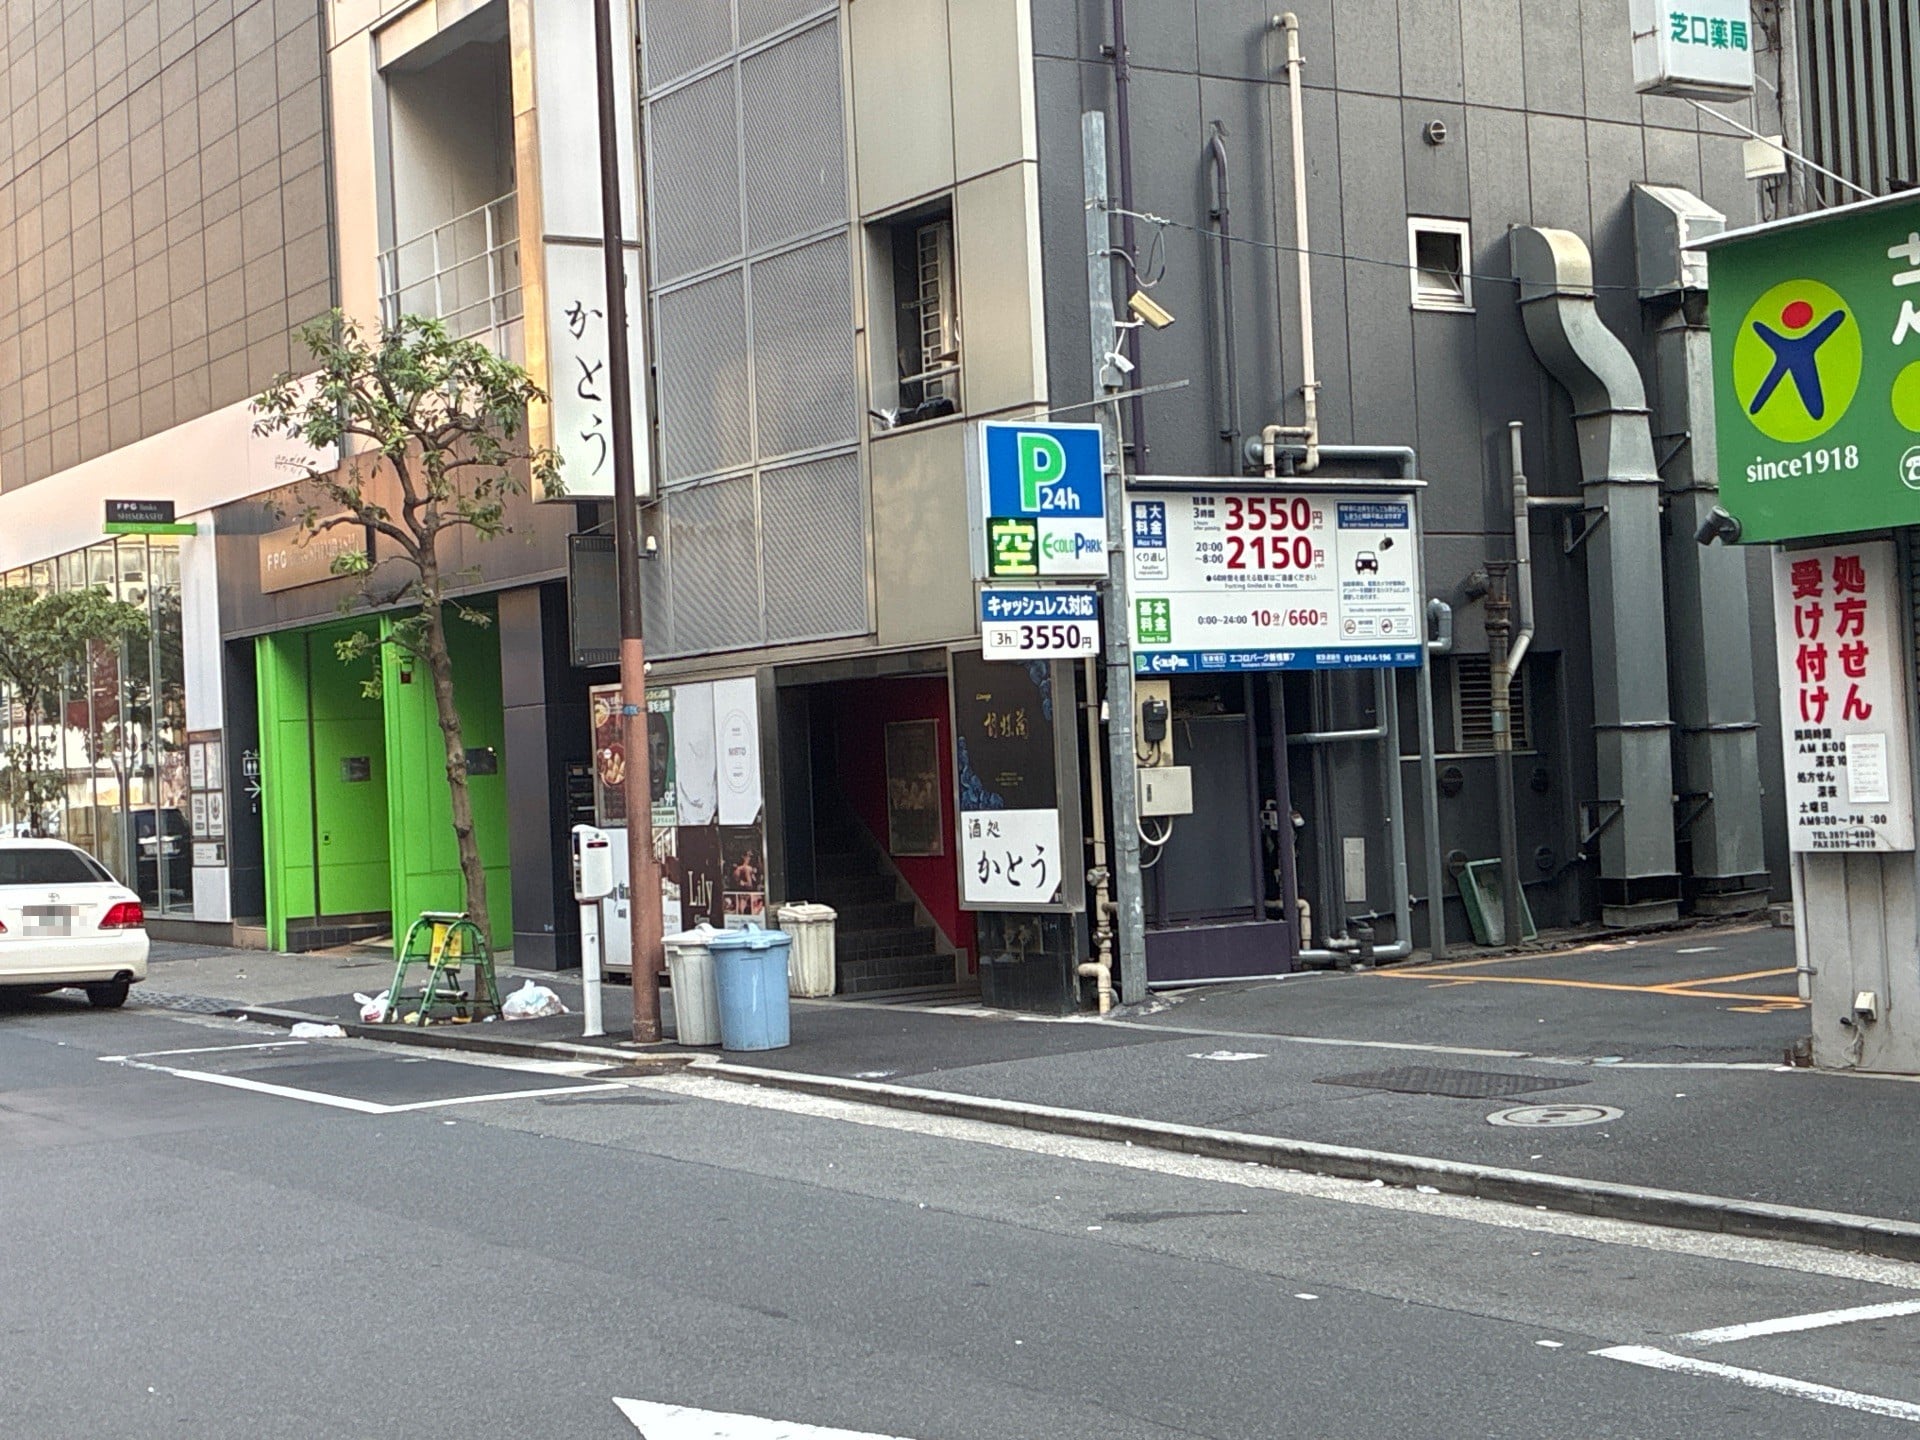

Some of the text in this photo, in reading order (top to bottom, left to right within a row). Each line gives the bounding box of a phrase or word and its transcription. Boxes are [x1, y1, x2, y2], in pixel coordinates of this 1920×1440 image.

[1669, 11, 1749, 52] 芝口薬局
[564, 299, 608, 477] かとう
[1017, 431, 1081, 513] P 24h
[1745, 444, 1860, 484] since1918
[1224, 496, 1323, 532] 3550円
[991, 518, 1039, 576] 空
[1196, 541, 1224, 552] 20:00
[1226, 535, 1325, 570] 2150円
[987, 594, 1094, 618] キャッシュレス対応
[996, 624, 1093, 650] 3h 3550円
[1791, 557, 1830, 725] 受け付け
[1832, 555, 1873, 722] 処方せん
[1799, 743, 1817, 754] AM
[1797, 771, 1835, 784] 処方せん
[1799, 802, 1829, 814] 土曜日
[968, 817, 1001, 840] 酒処
[1812, 831, 1828, 840] TEL
[1812, 839, 1829, 849] FAX
[976, 843, 1047, 889] かとう
[687, 869, 714, 916] Lily
